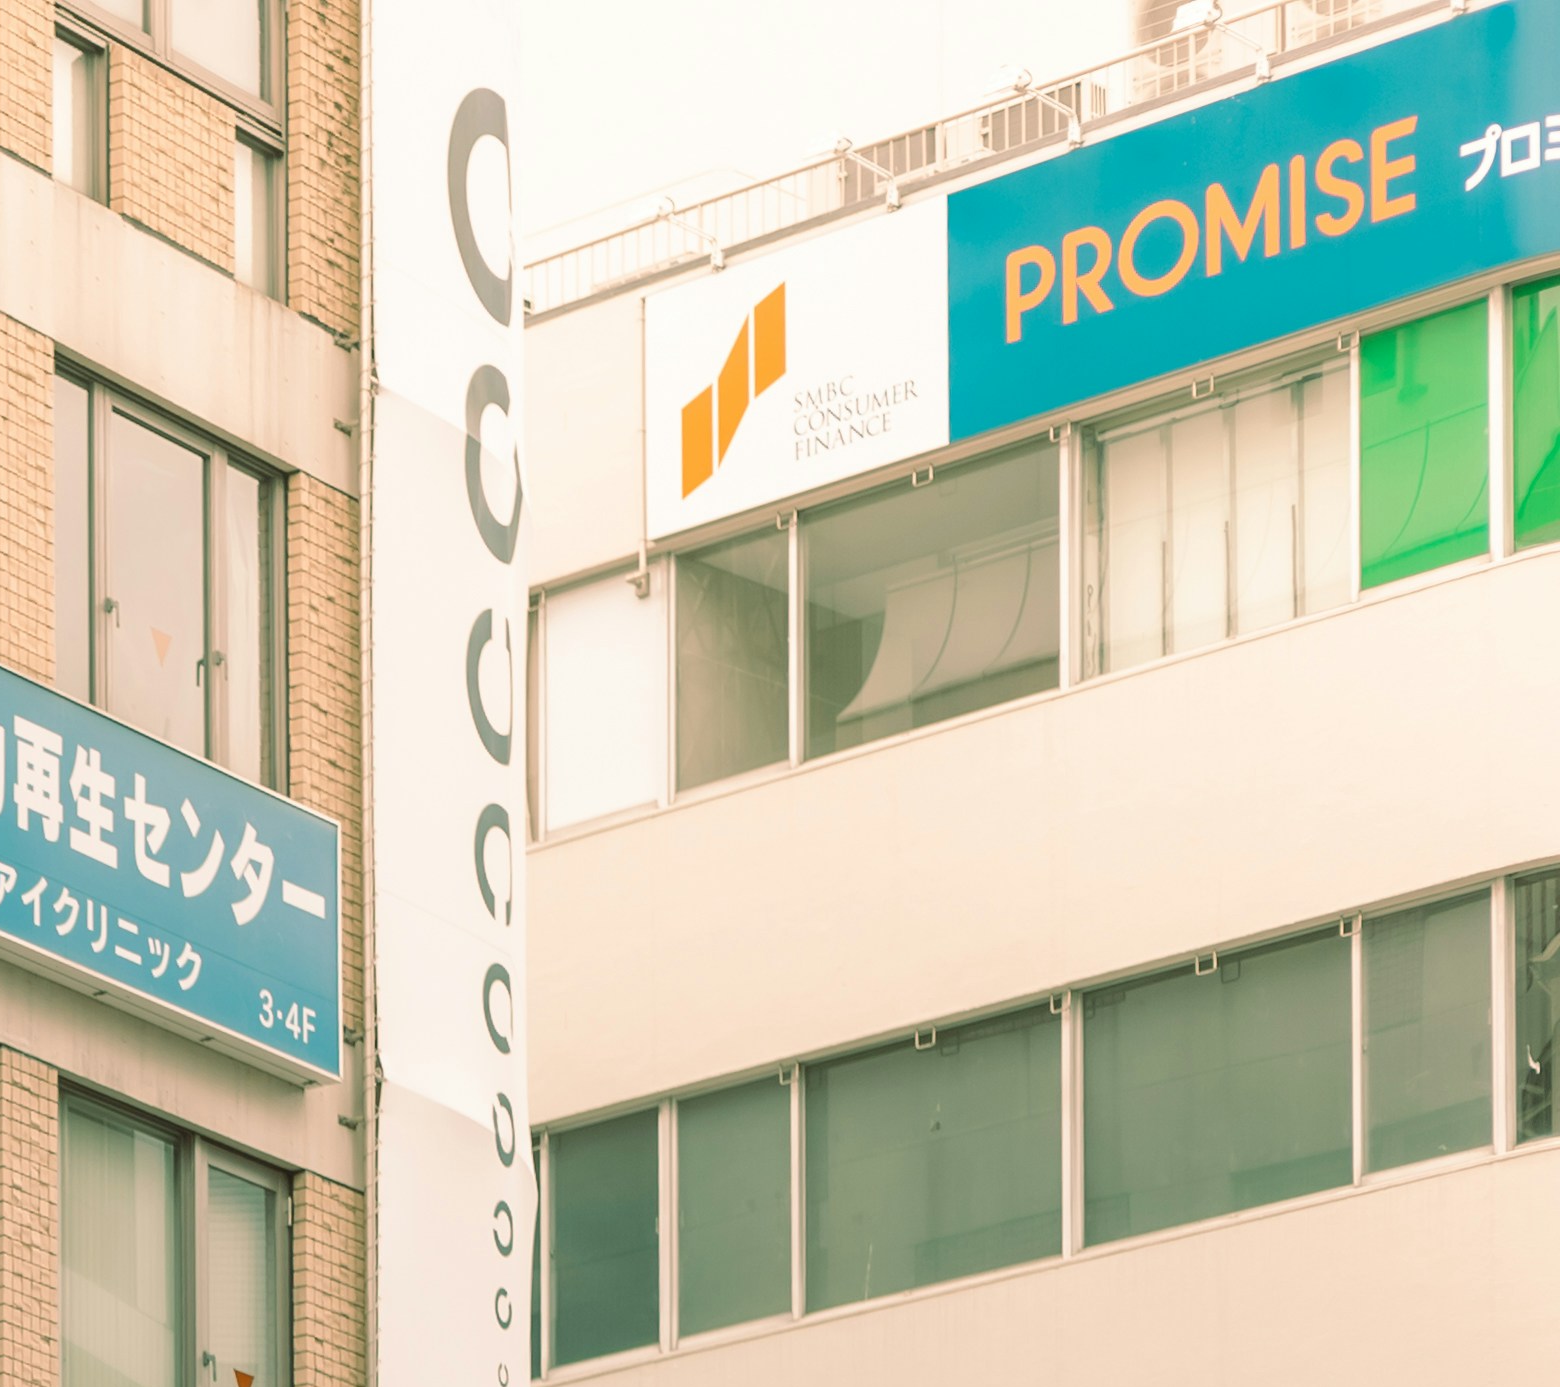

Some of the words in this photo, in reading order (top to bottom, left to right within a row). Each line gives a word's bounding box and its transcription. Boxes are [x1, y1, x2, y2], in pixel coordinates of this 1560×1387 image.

[1005, 115, 1419, 345] PROMISE
[793, 374, 854, 413] SMBC
[794, 379, 919, 437] CONSUMER
[795, 411, 892, 461] FINANCE
